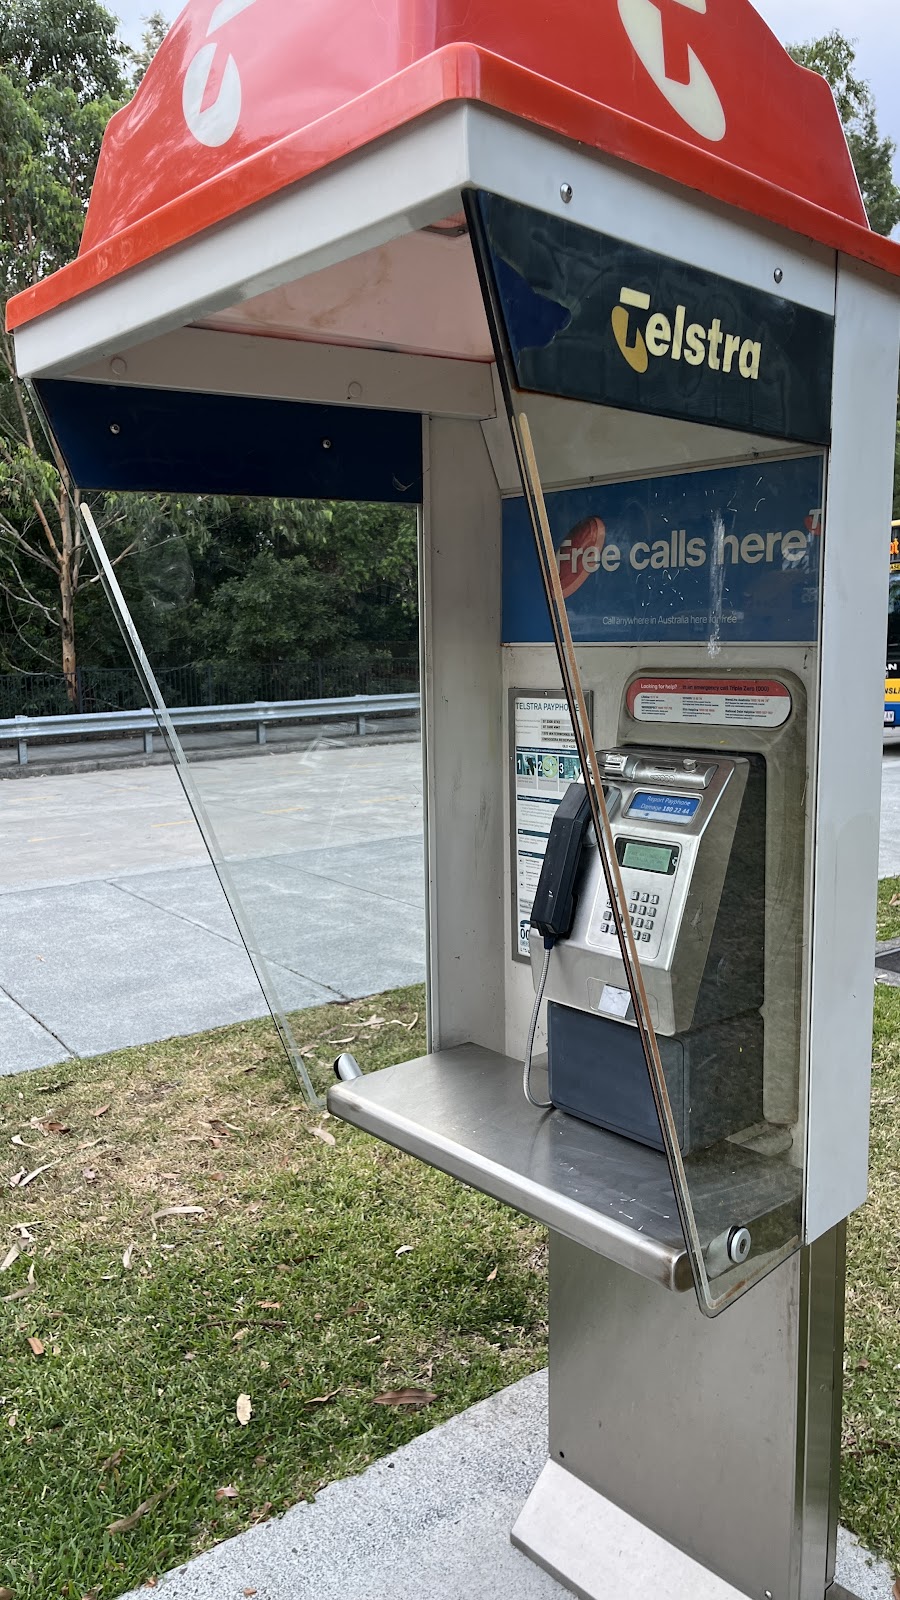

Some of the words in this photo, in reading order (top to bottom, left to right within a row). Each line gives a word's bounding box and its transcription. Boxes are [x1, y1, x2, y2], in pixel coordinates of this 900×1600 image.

[611, 286, 762, 380] Telstra
[556, 538, 621, 574] Free
[629, 529, 708, 570] calls
[715, 529, 808, 565] here
[602, 616, 617, 625] Call
[618, 616, 649, 626] anywhere
[650, 616, 656, 624] in
[657, 615, 689, 624] Australia
[690, 615, 708, 624] here
[721, 614, 737, 623] free
[544, 703, 579, 711] PAYPHOE
[518, 760, 521, 769] 1
[538, 761, 542, 771] 2
[560, 763, 563, 773] 3
[640, 803, 661, 811] Damage
[664, 798, 691, 806] Payphone
